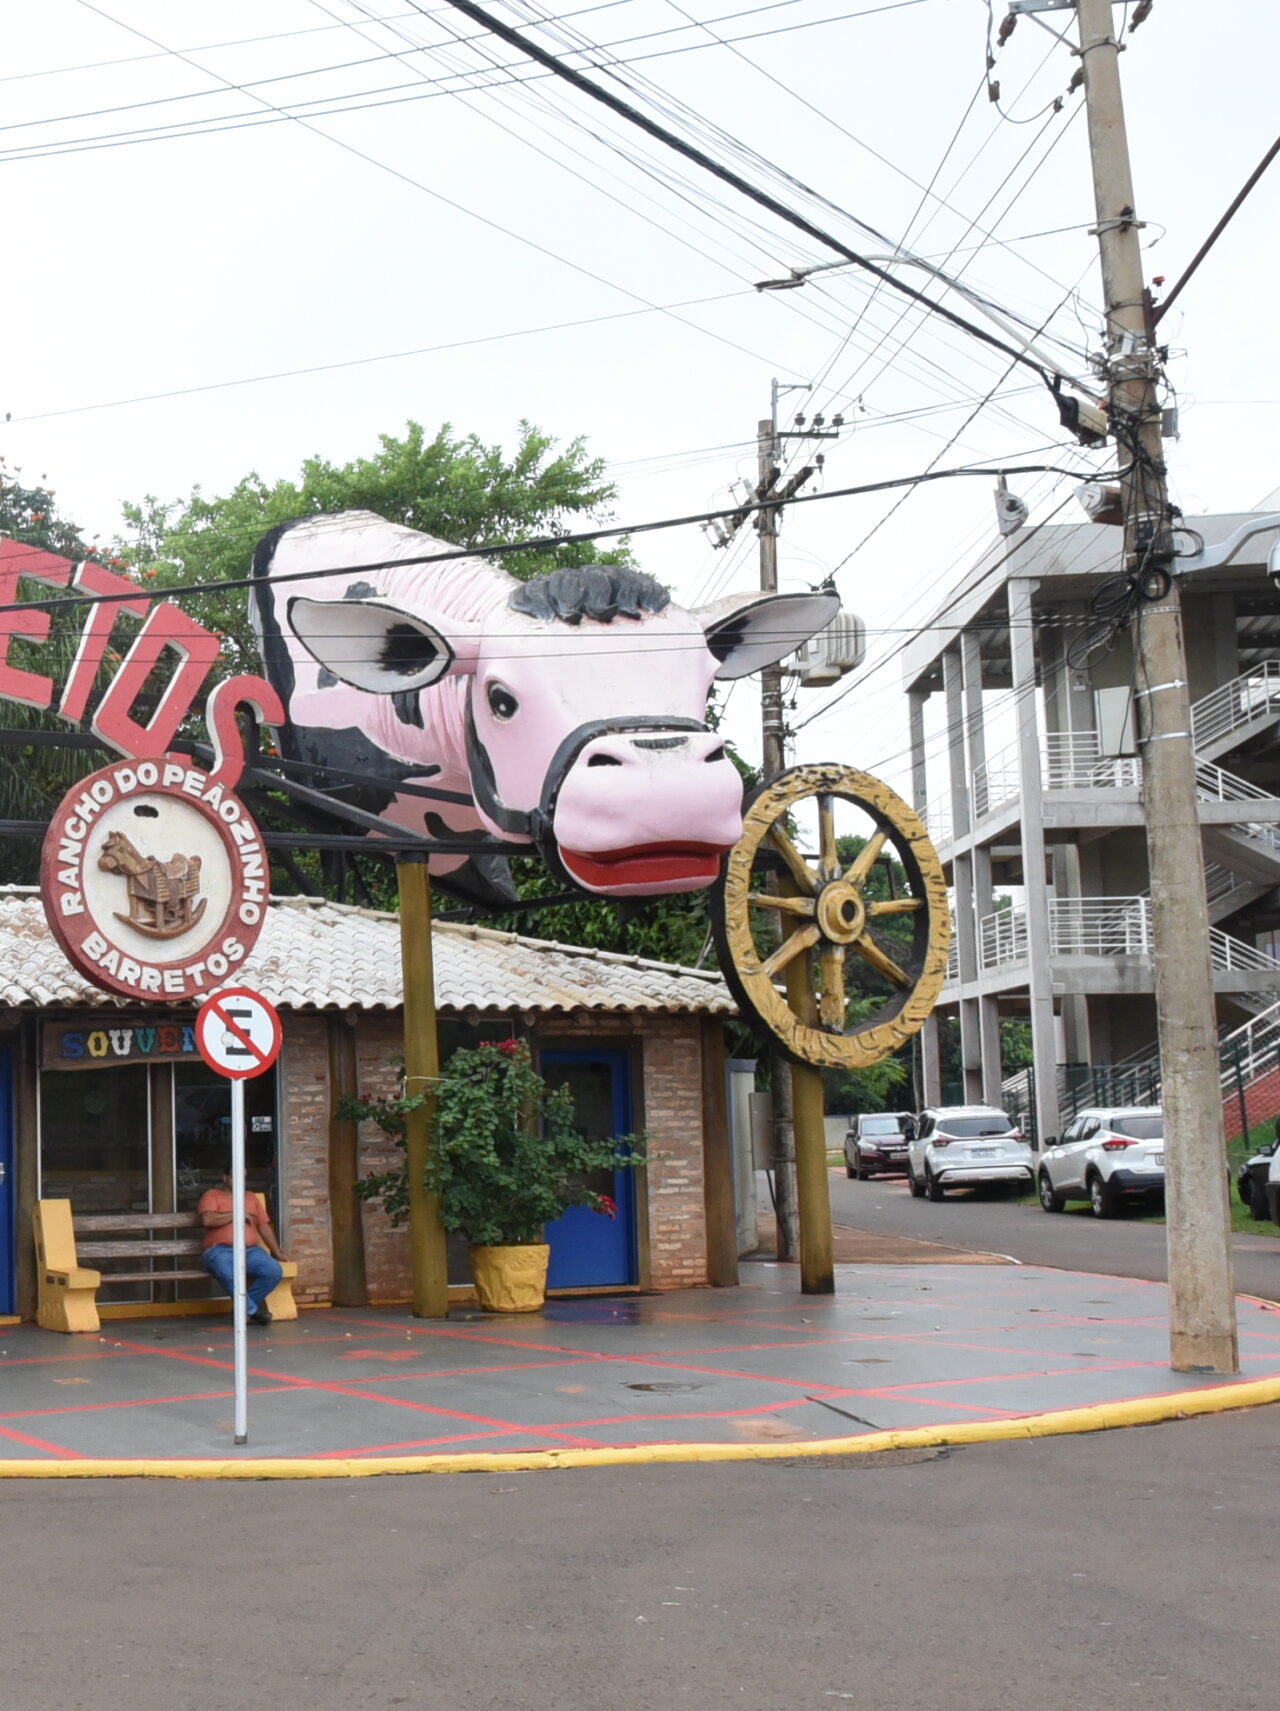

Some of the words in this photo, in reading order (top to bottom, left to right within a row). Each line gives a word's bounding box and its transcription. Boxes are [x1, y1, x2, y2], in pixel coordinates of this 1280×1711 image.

[58, 780, 114, 916] RANCHO
[113, 762, 158, 794] DO
[162, 763, 266, 926] PEÃOZINHO
[80, 931, 245, 993] BARRETOS
